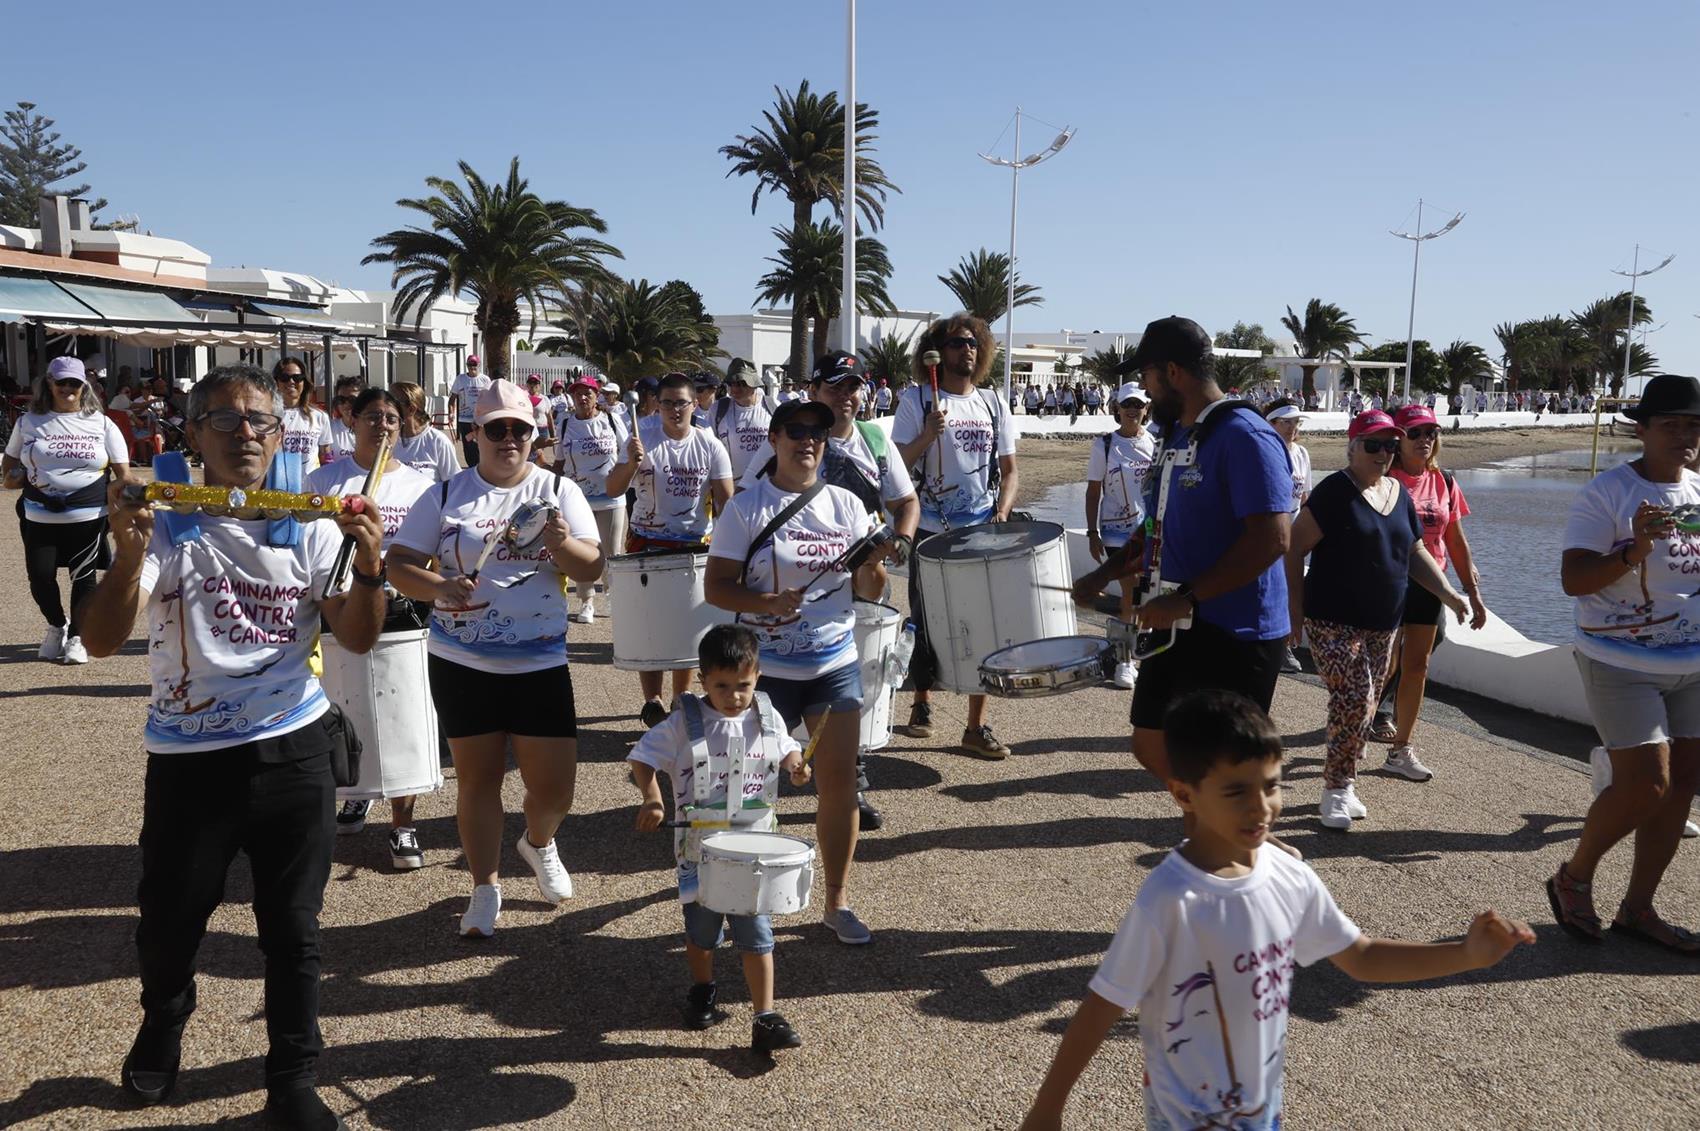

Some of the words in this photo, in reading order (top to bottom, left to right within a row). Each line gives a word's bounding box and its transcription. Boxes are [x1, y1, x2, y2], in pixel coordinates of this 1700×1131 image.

[45, 434, 99, 442] CAMINAMOS
[48, 442, 95, 451] CONTRA
[663, 465, 709, 476] CAMINAMOS
[203, 576, 310, 602] CAMINAMOS
[214, 599, 295, 626] CONTRA
[210, 624, 226, 638] EL
